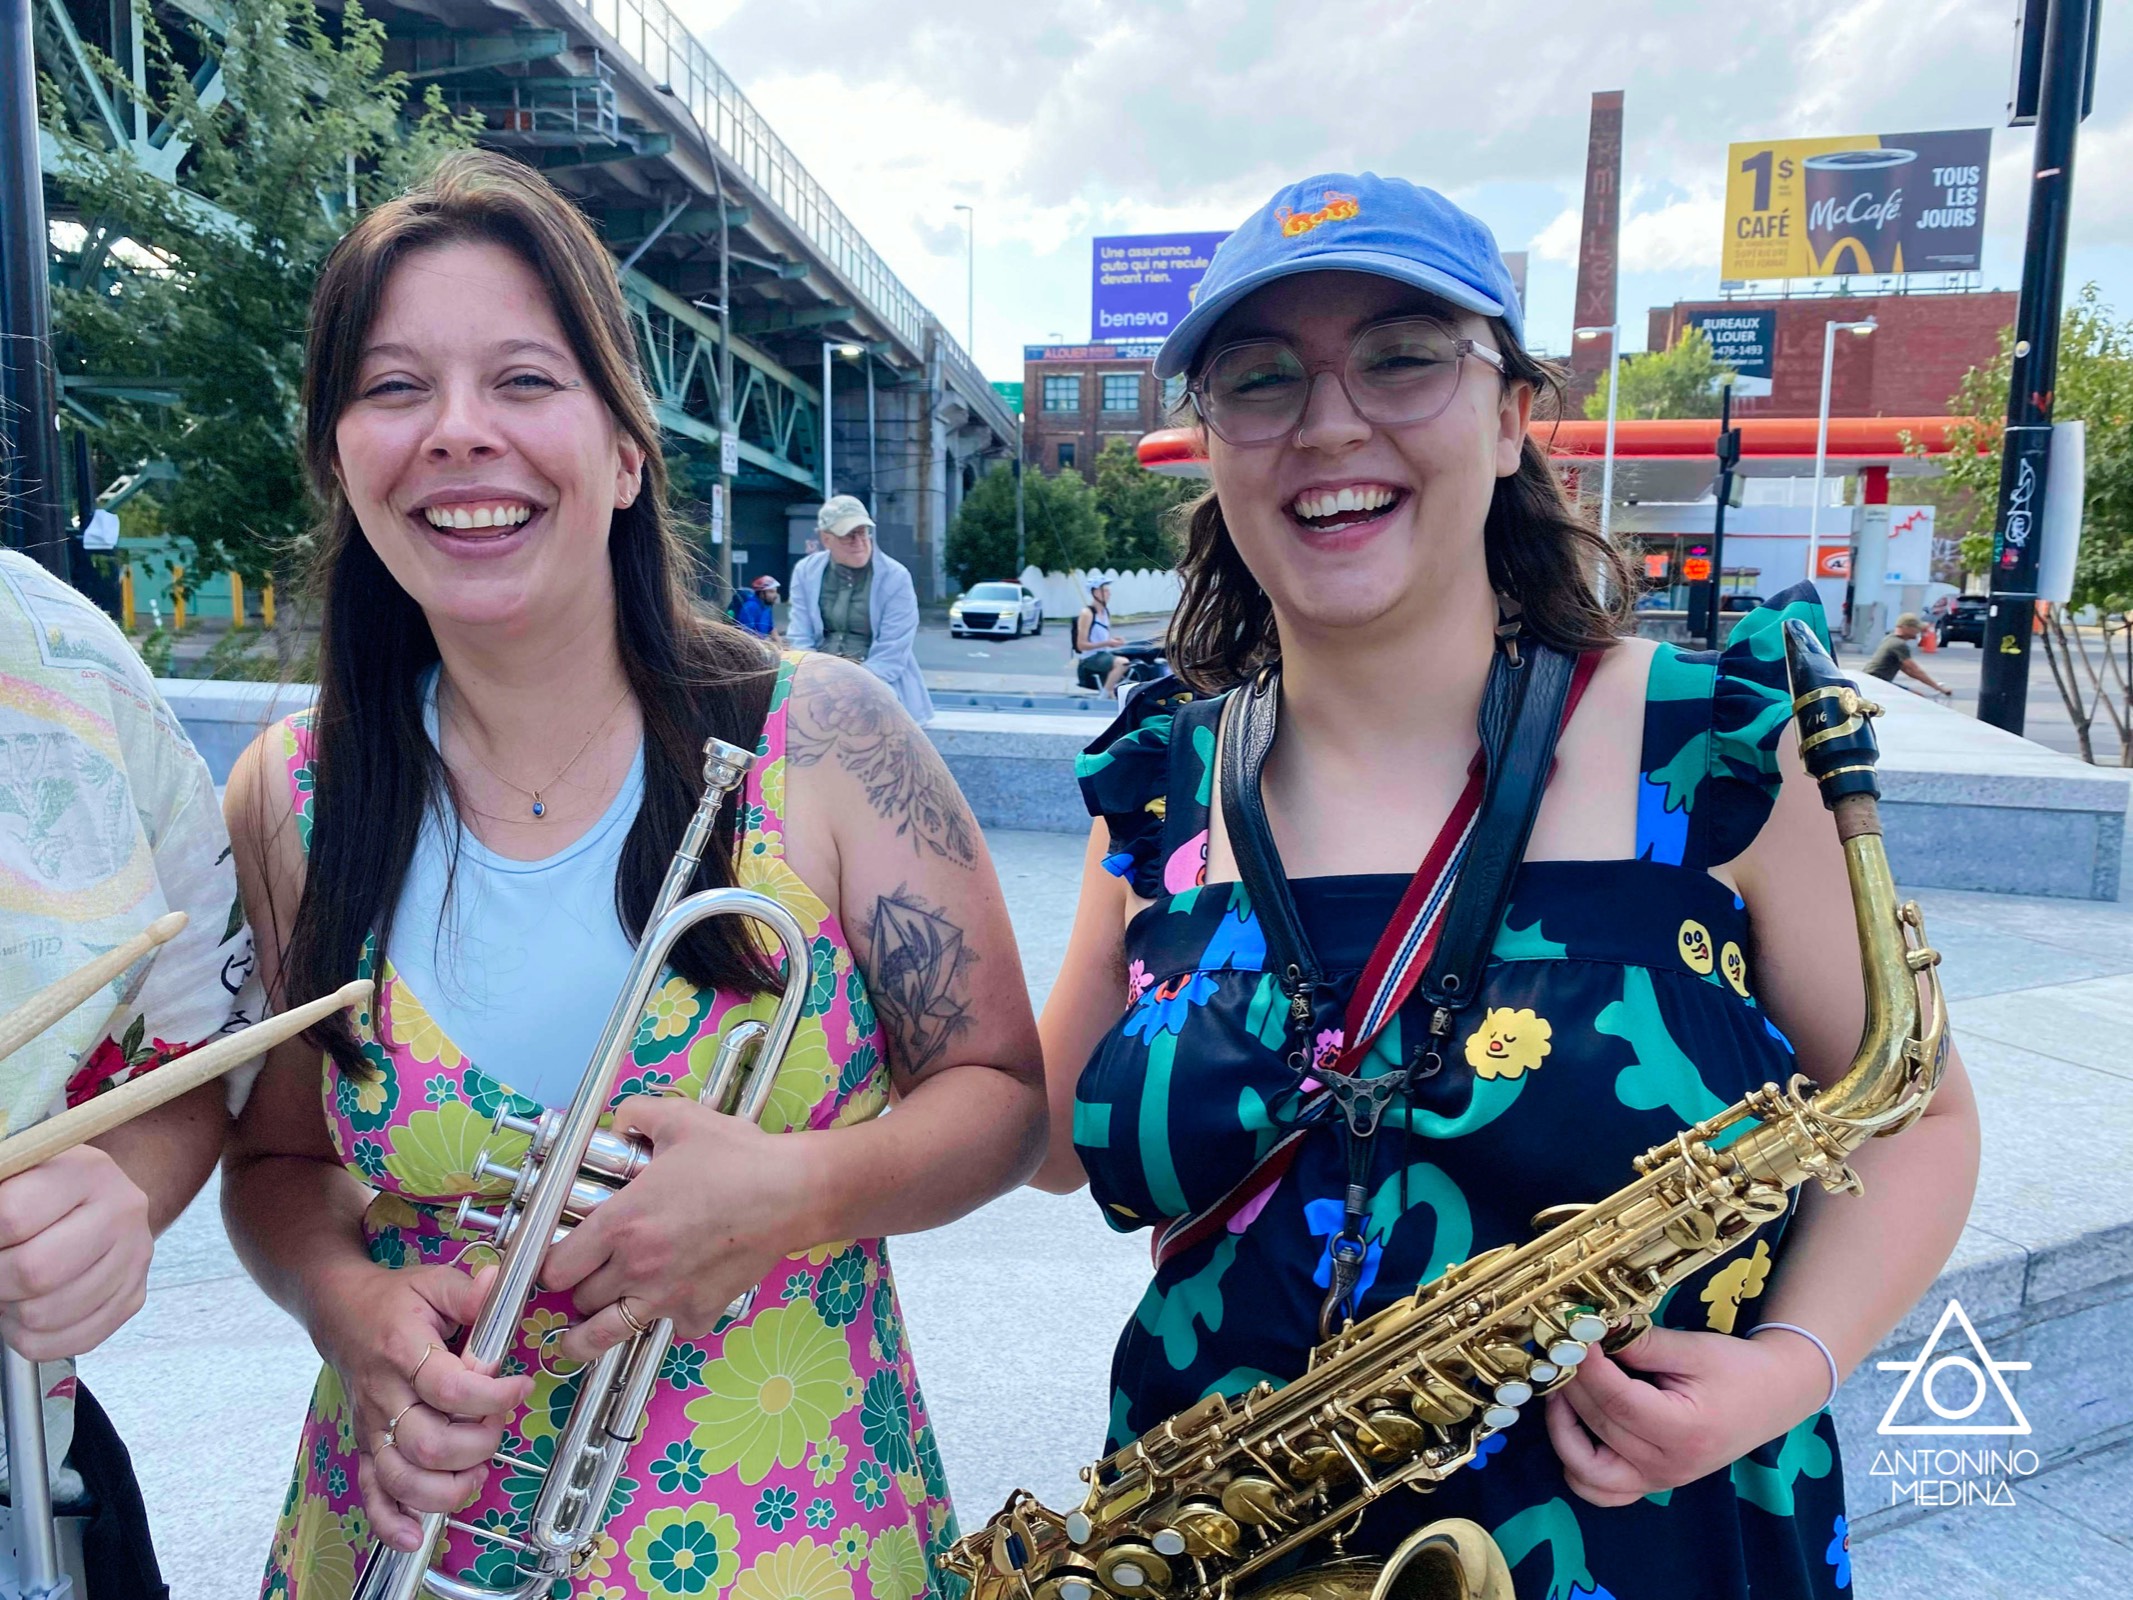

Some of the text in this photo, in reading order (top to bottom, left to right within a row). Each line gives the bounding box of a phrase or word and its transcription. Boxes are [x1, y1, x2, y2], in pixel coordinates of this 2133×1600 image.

[1741, 150, 1794, 211] 1 $
[1932, 166, 1980, 187] TOUS
[1946, 188, 1978, 207] LES
[1809, 188, 1903, 231] McCafé
[1916, 207, 1977, 229] JOURS
[1737, 208, 1790, 239] CAFÉ
[1101, 245, 1191, 259] Une assurance
[1100, 256, 1209, 274] auto qui ne recule
[1100, 271, 1173, 285] devant rien.
[1100, 309, 1168, 327] beneva
[1703, 317, 1760, 330] BUREAUX
[1702, 329, 1756, 343] À LOUER
